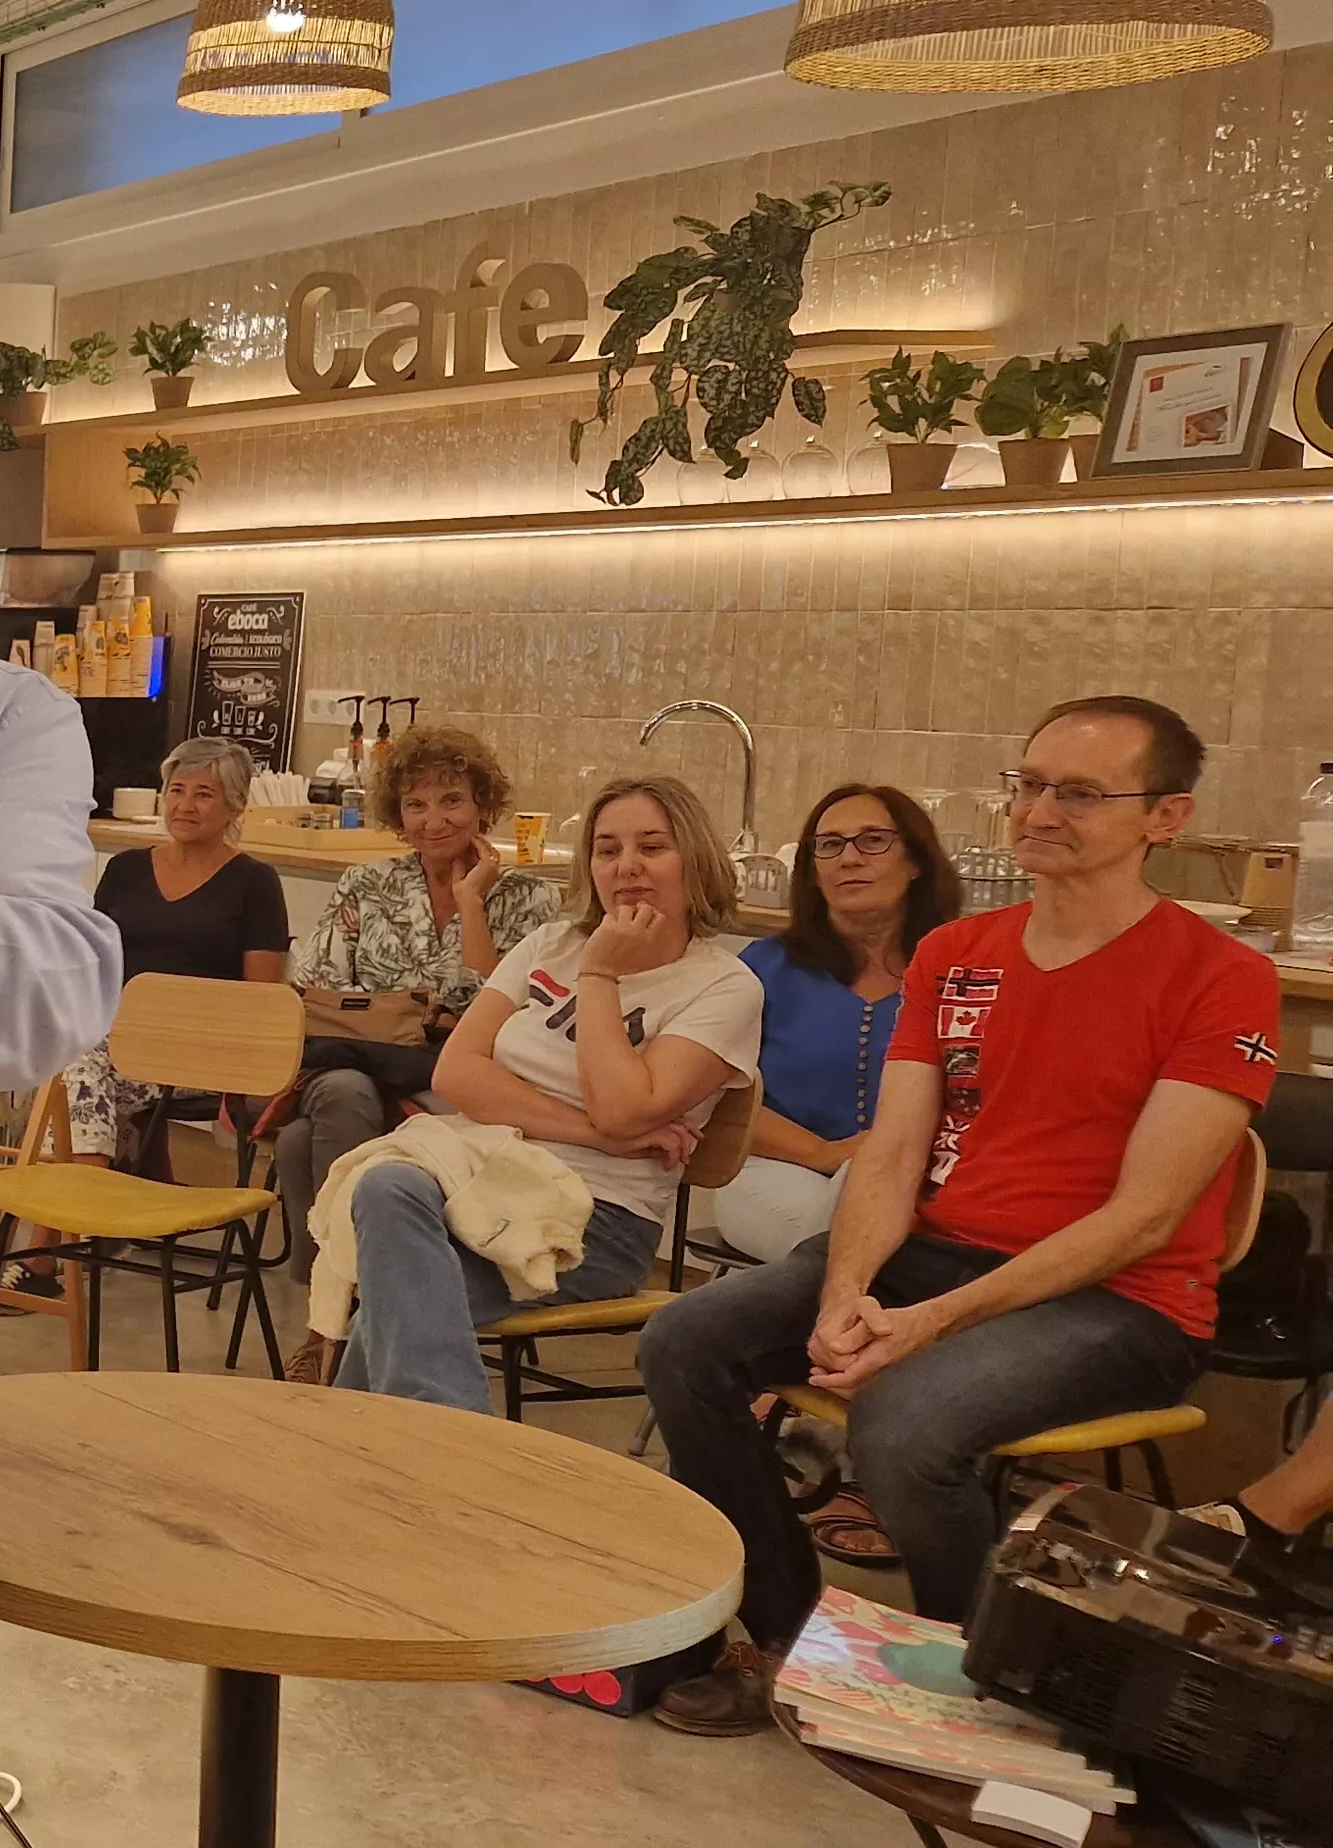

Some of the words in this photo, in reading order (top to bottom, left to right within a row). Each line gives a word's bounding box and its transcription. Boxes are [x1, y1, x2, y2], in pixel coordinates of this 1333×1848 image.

[228, 609, 269, 630] eboca
[210, 646, 253, 657] COMERCIO
[254, 645, 282, 657] JUSTO
